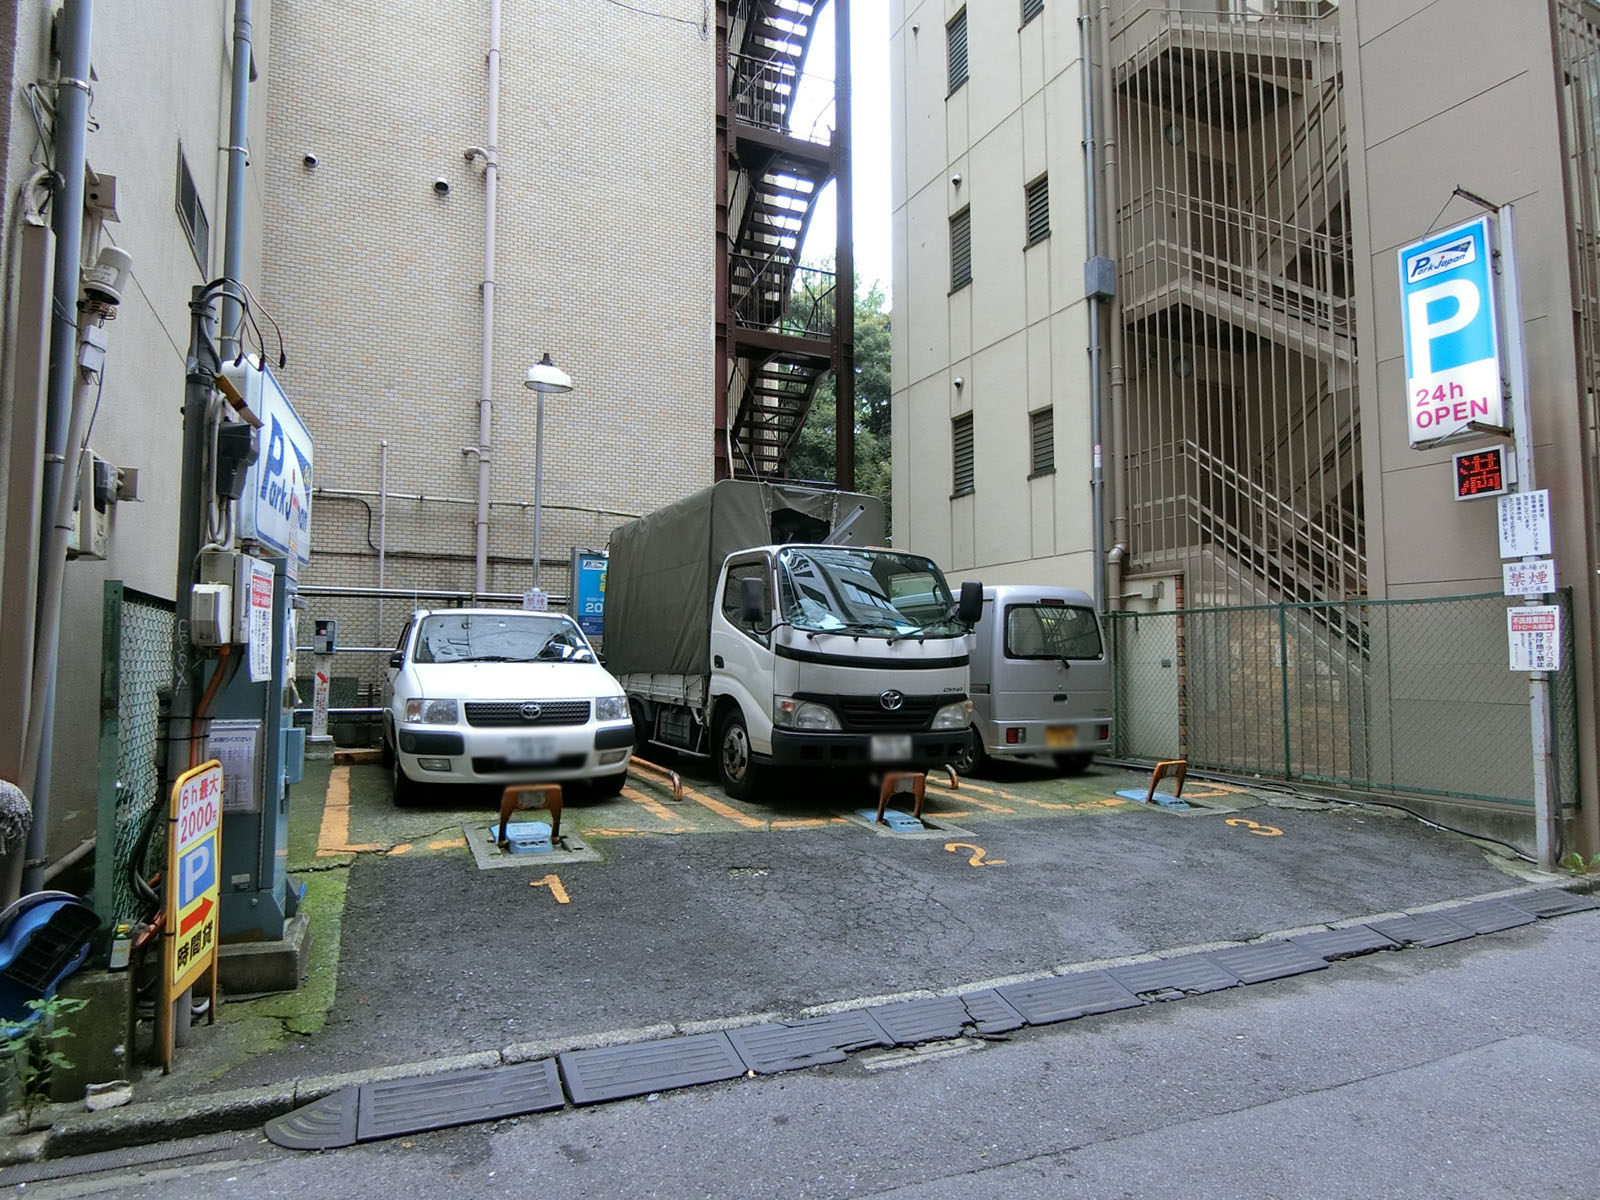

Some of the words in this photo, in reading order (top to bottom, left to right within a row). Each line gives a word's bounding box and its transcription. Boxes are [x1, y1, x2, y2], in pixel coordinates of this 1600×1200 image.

[1411, 256, 1433, 278] Park
[1434, 254, 1466, 270] Japan
[1408, 279, 1480, 378] P
[1416, 382, 1464, 407] 24h
[1416, 397, 1489, 429] OPEN
[260, 411, 287, 515] Park
[1509, 571, 1549, 587] 禁煙
[1225, 818, 1284, 836] 3
[944, 842, 1007, 867] 2
[185, 846, 210, 903] P
[177, 919, 213, 972] 時間貸
